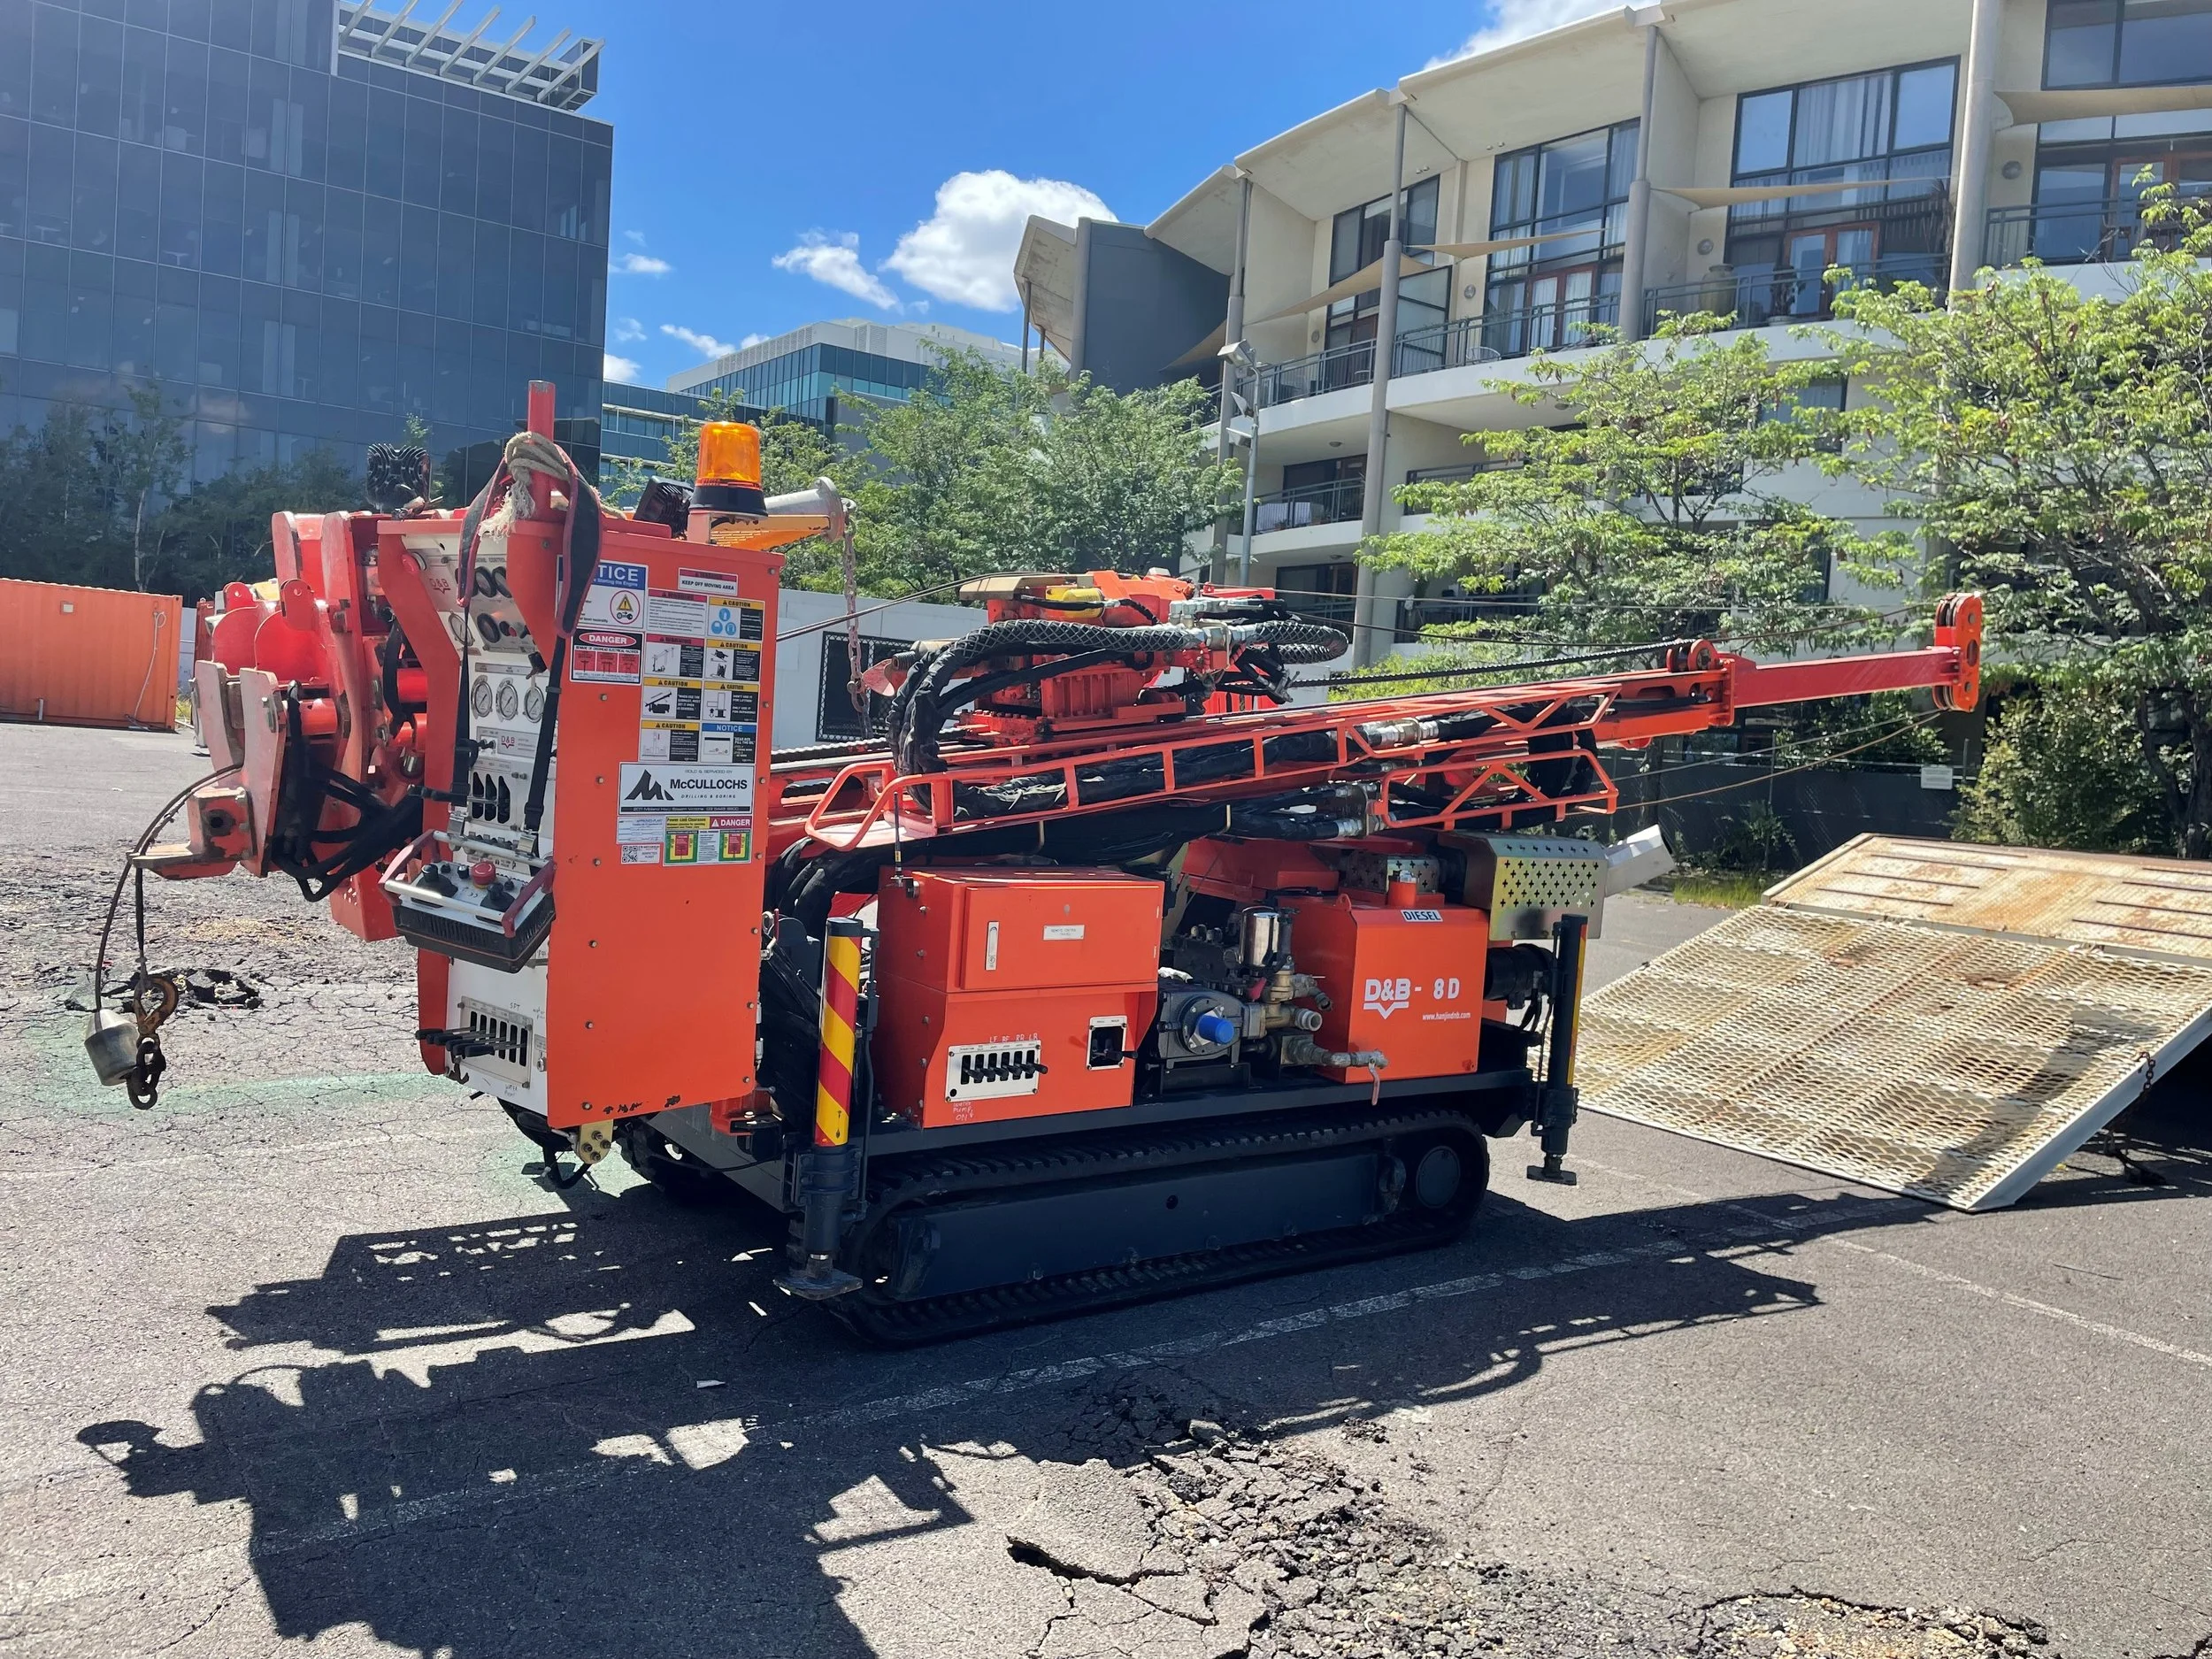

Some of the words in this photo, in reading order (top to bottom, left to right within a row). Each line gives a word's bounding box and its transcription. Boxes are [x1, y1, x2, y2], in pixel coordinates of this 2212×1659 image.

[589, 635, 627, 644] DANGER
[670, 779, 747, 789] McCULLOCHS
[1403, 910, 1441, 921] DIESEL
